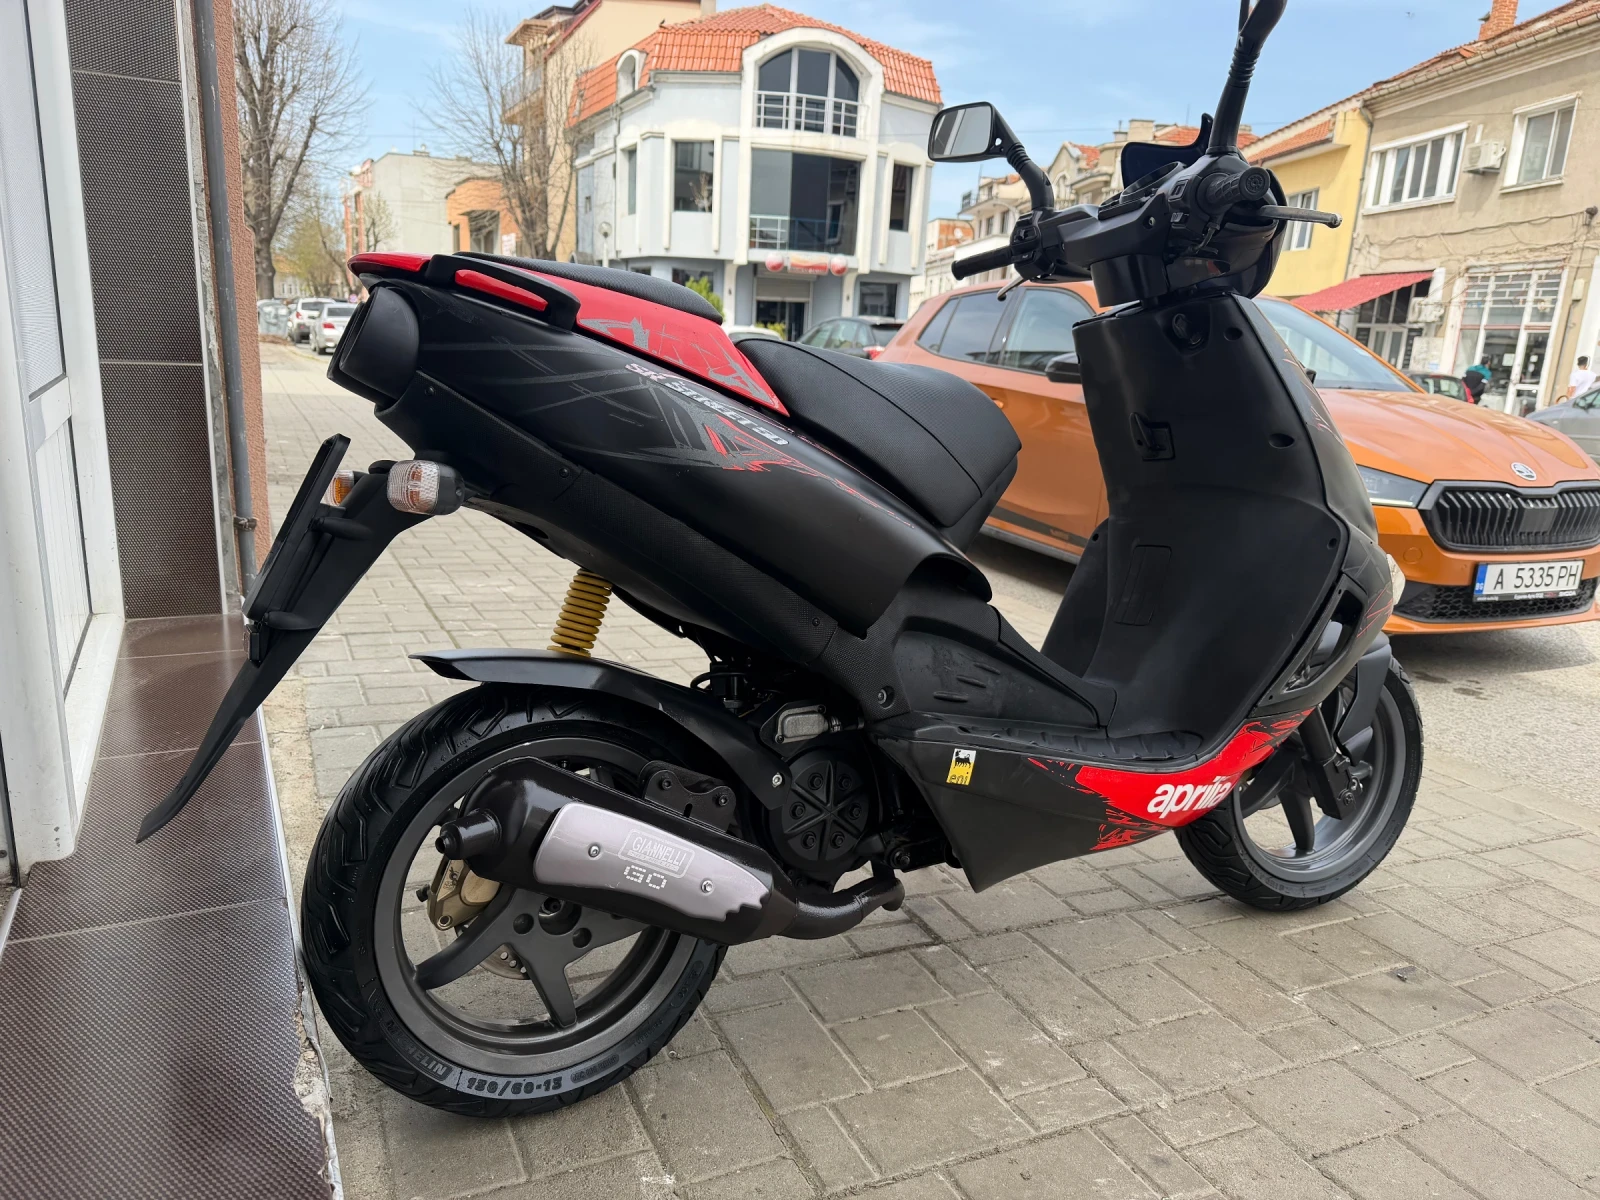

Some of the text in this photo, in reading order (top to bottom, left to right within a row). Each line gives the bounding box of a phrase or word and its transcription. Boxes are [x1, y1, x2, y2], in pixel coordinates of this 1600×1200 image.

[1493, 568, 1504, 590] A
[947, 770, 970, 786] eni
[1147, 775, 1232, 818] aprilia
[632, 836, 688, 866] GIANNELLI
[466, 1076, 563, 1097] 130/60-13
